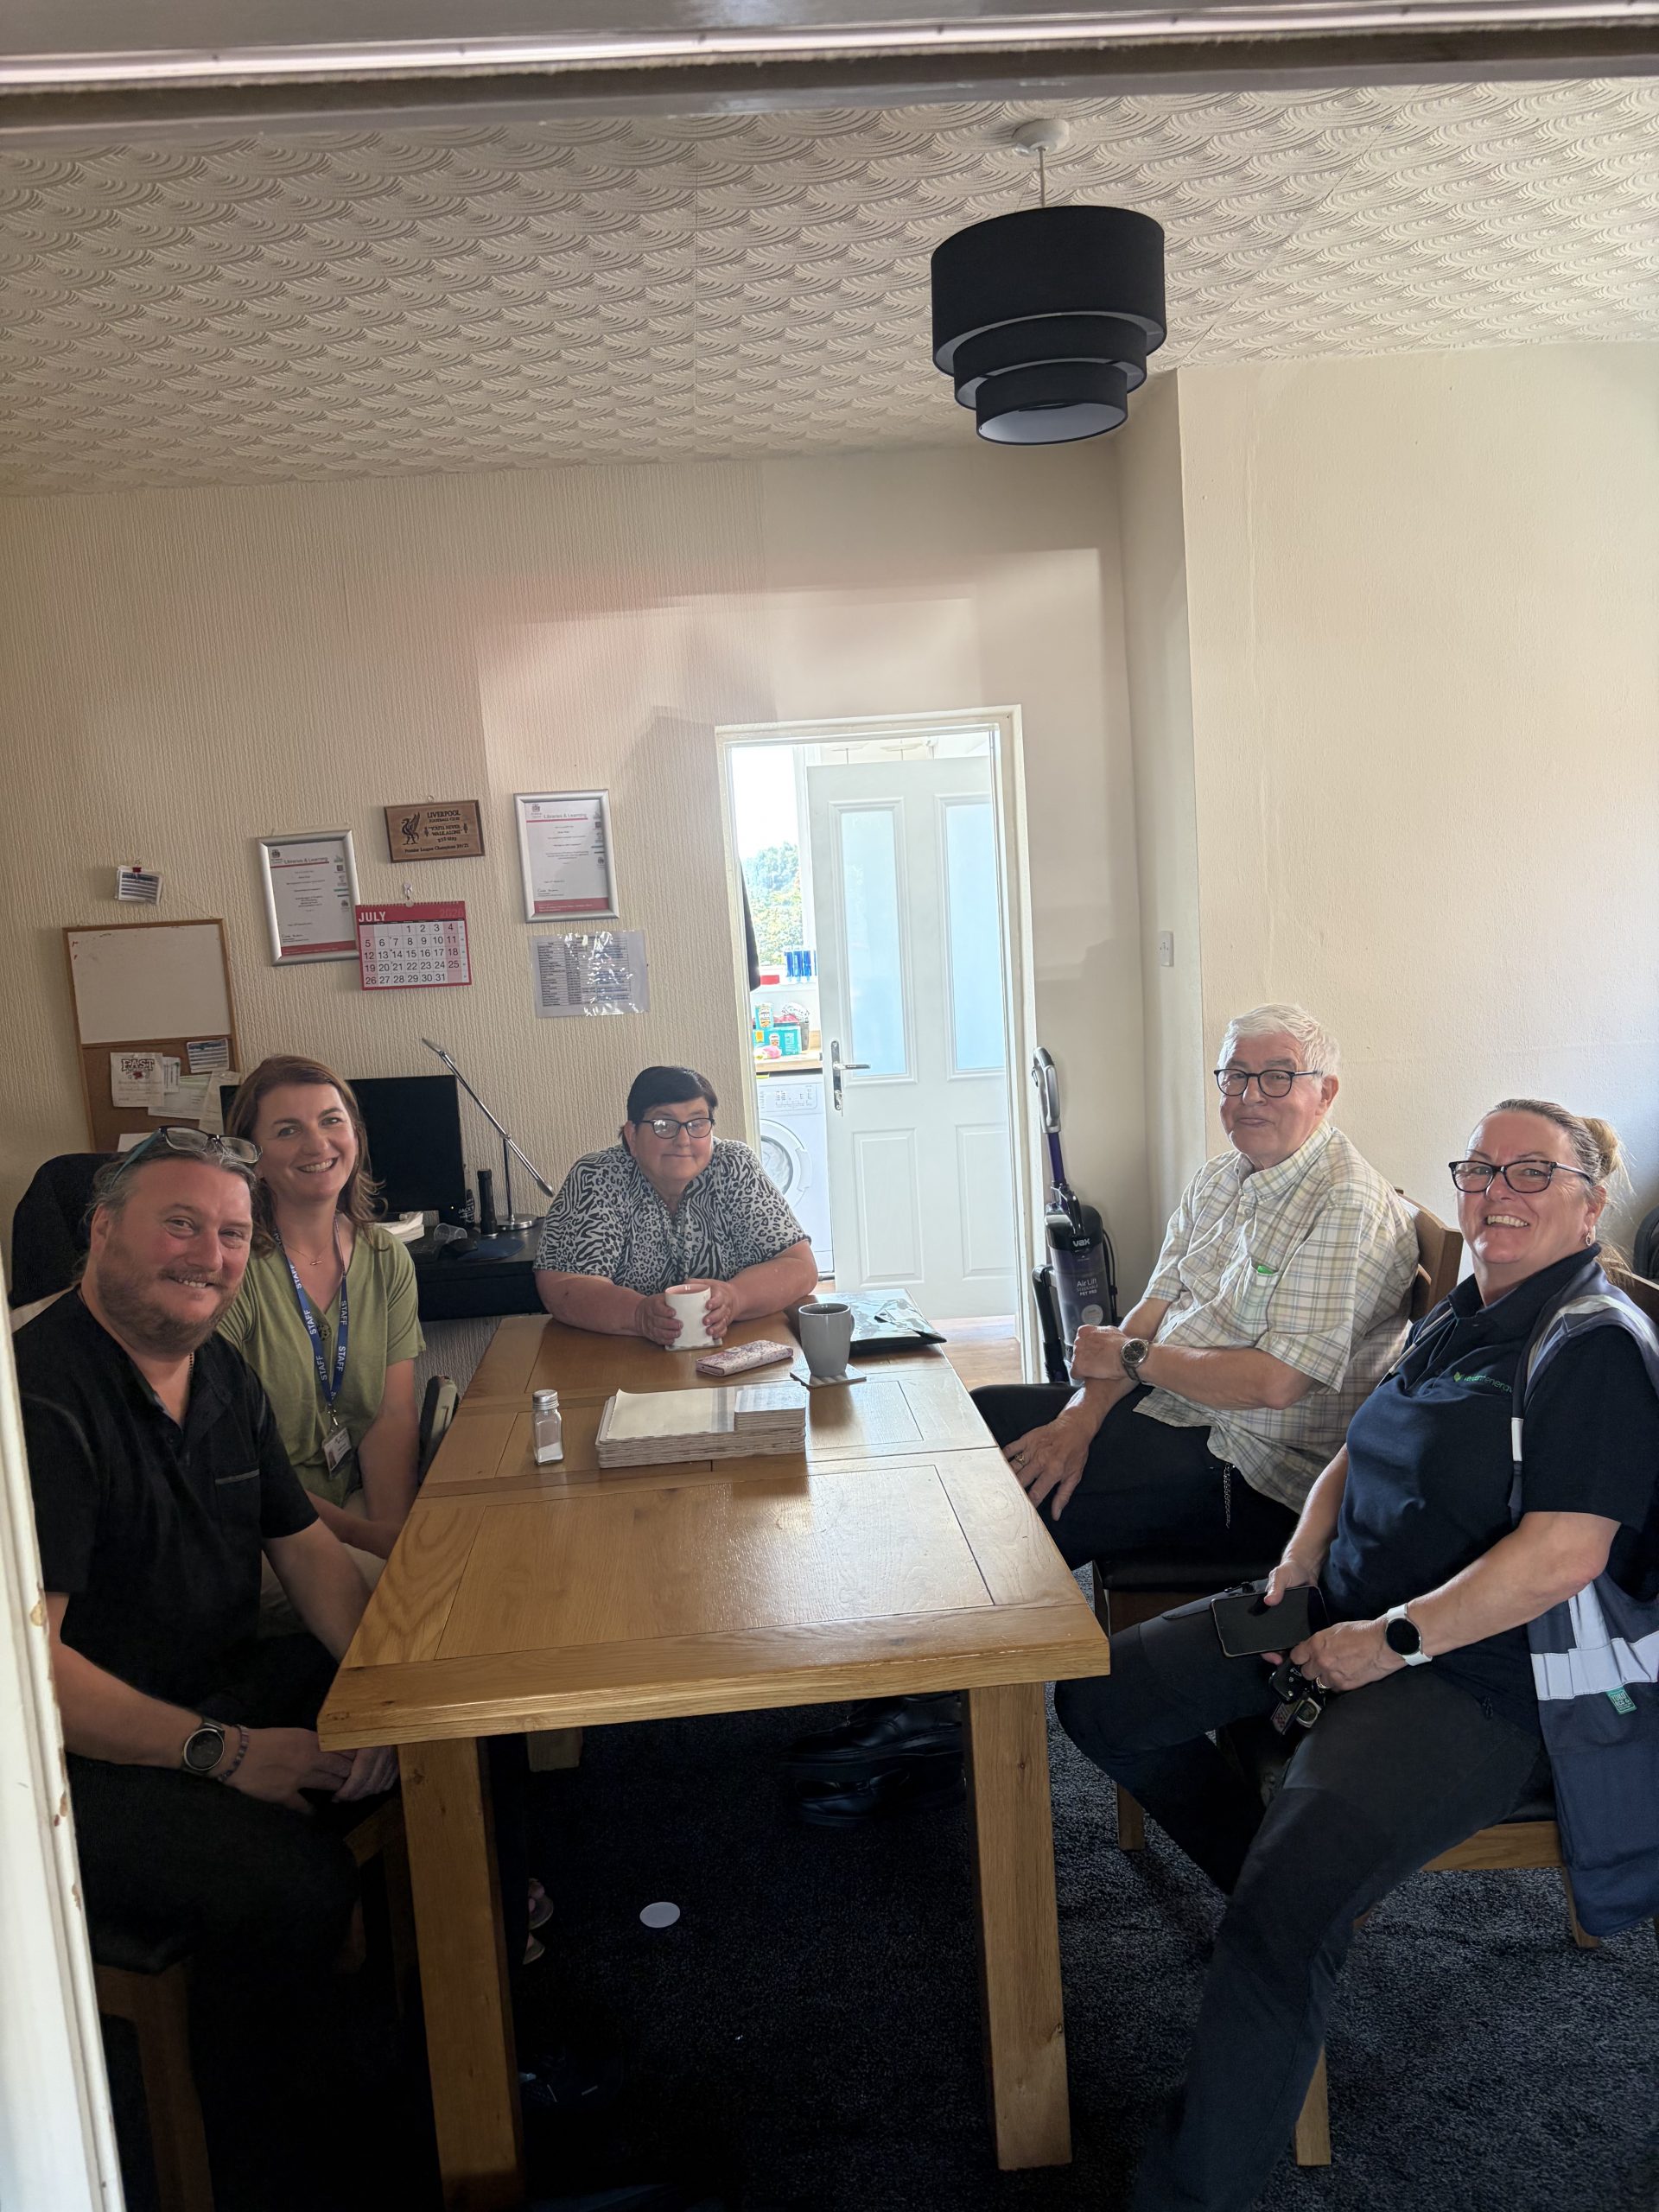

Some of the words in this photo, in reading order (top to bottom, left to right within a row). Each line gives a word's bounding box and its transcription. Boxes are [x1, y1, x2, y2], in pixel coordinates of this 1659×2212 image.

[427, 810, 461, 818] LIVERPOOL
[359, 911, 385, 922] JULY
[378, 938, 385, 947] 6
[421, 937, 427, 945] 9
[433, 936, 443, 944] 10
[365, 951, 374, 960] 12
[392, 963, 403, 971] 21
[406, 962, 417, 970] 22
[365, 976, 377, 985] 26
[304, 1309, 317, 1335] STAFF
[336, 1345, 346, 1372] STAFF
[315, 1355, 327, 1381] STAFF
